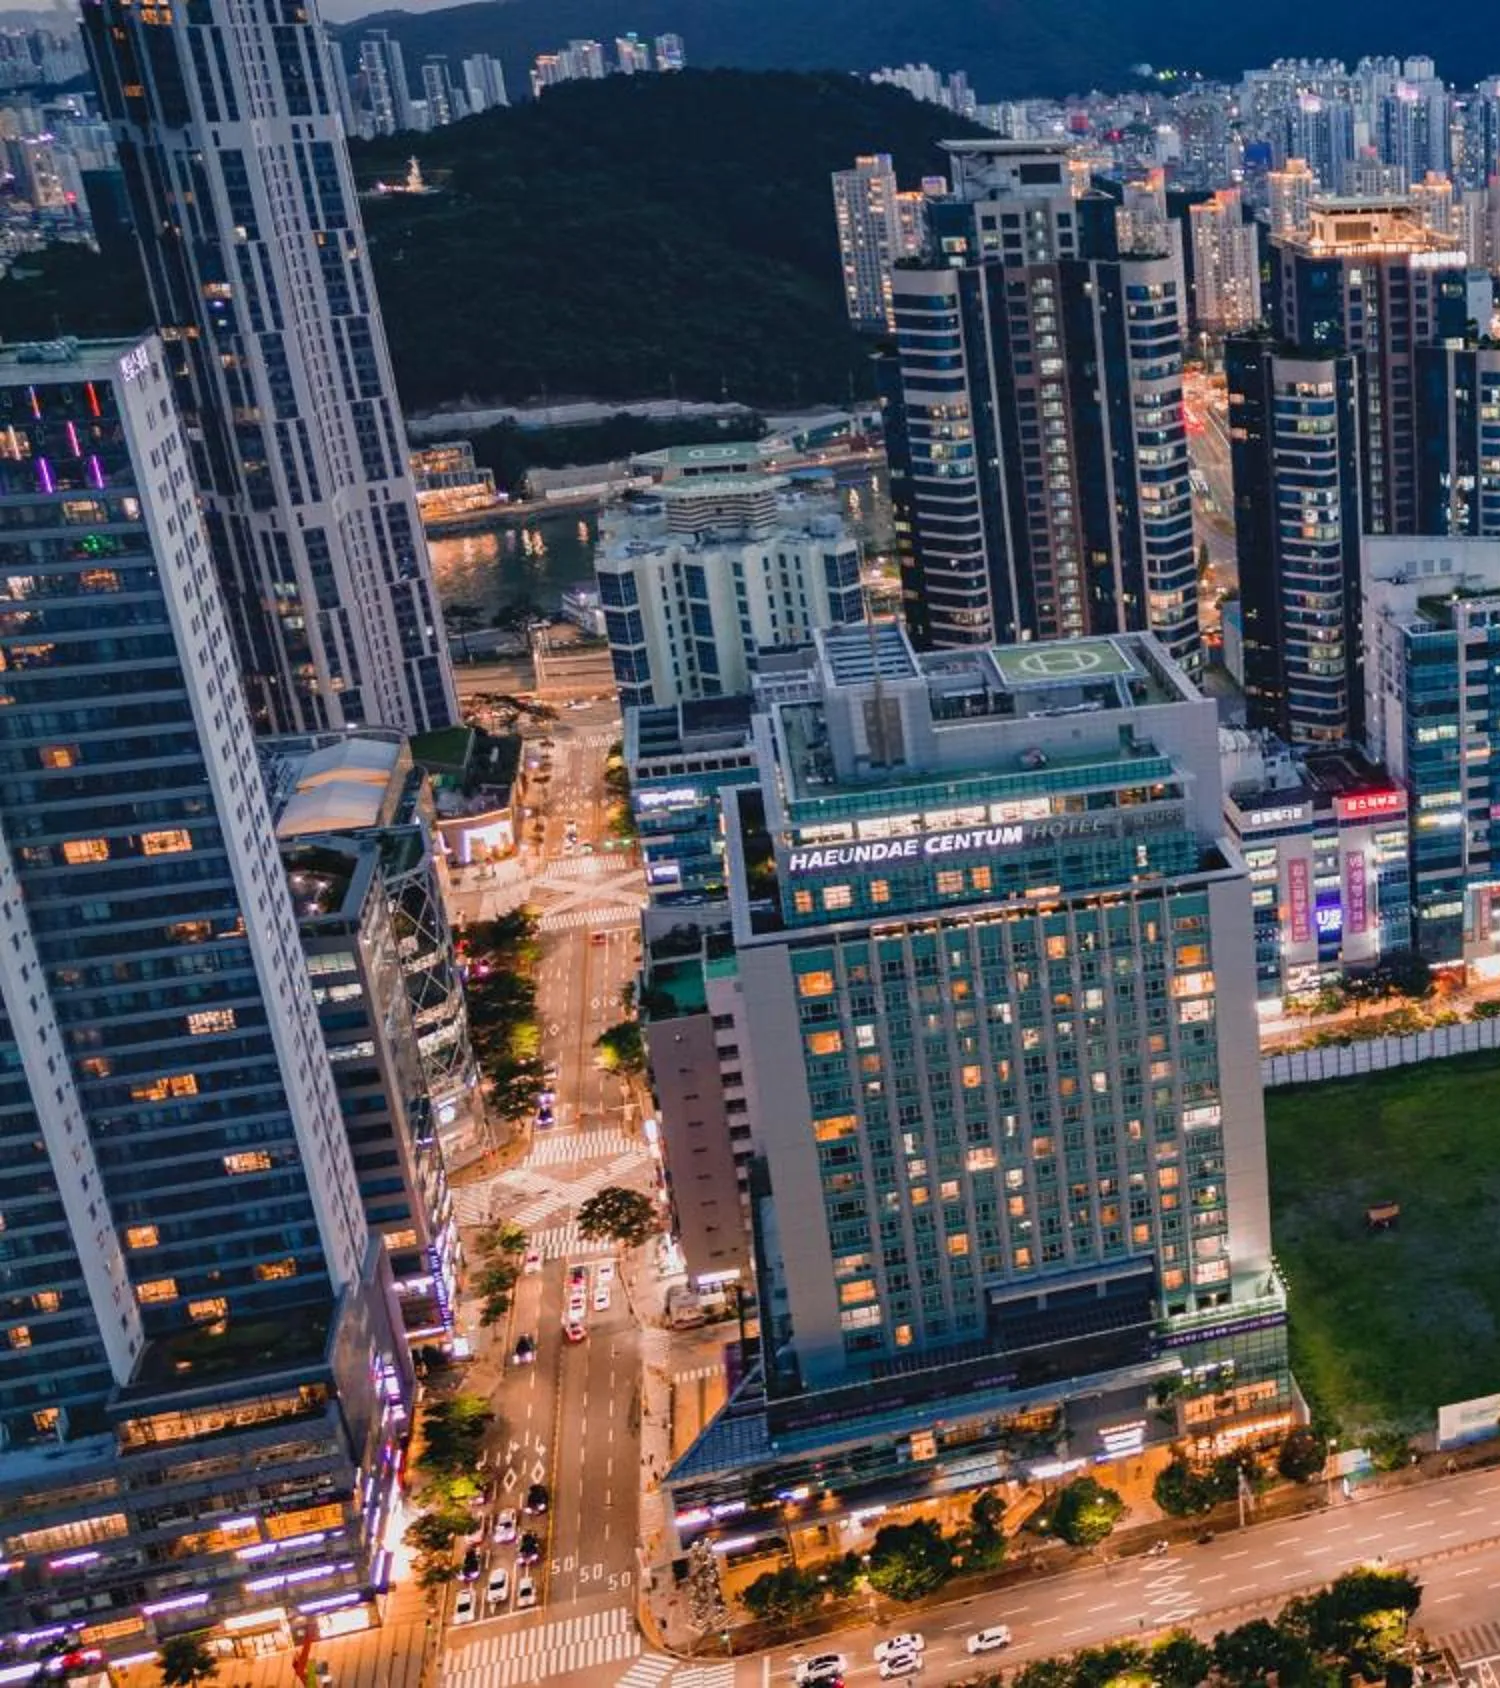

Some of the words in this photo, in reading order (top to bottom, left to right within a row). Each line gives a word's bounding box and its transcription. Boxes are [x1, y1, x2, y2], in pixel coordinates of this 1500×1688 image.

[789, 840, 918, 872] HAEUNDAE
[924, 826, 1024, 854] CENTUM
[551, 1556, 574, 1575] 50
[579, 1563, 604, 1584] 50
[607, 1571, 631, 1591] 50
